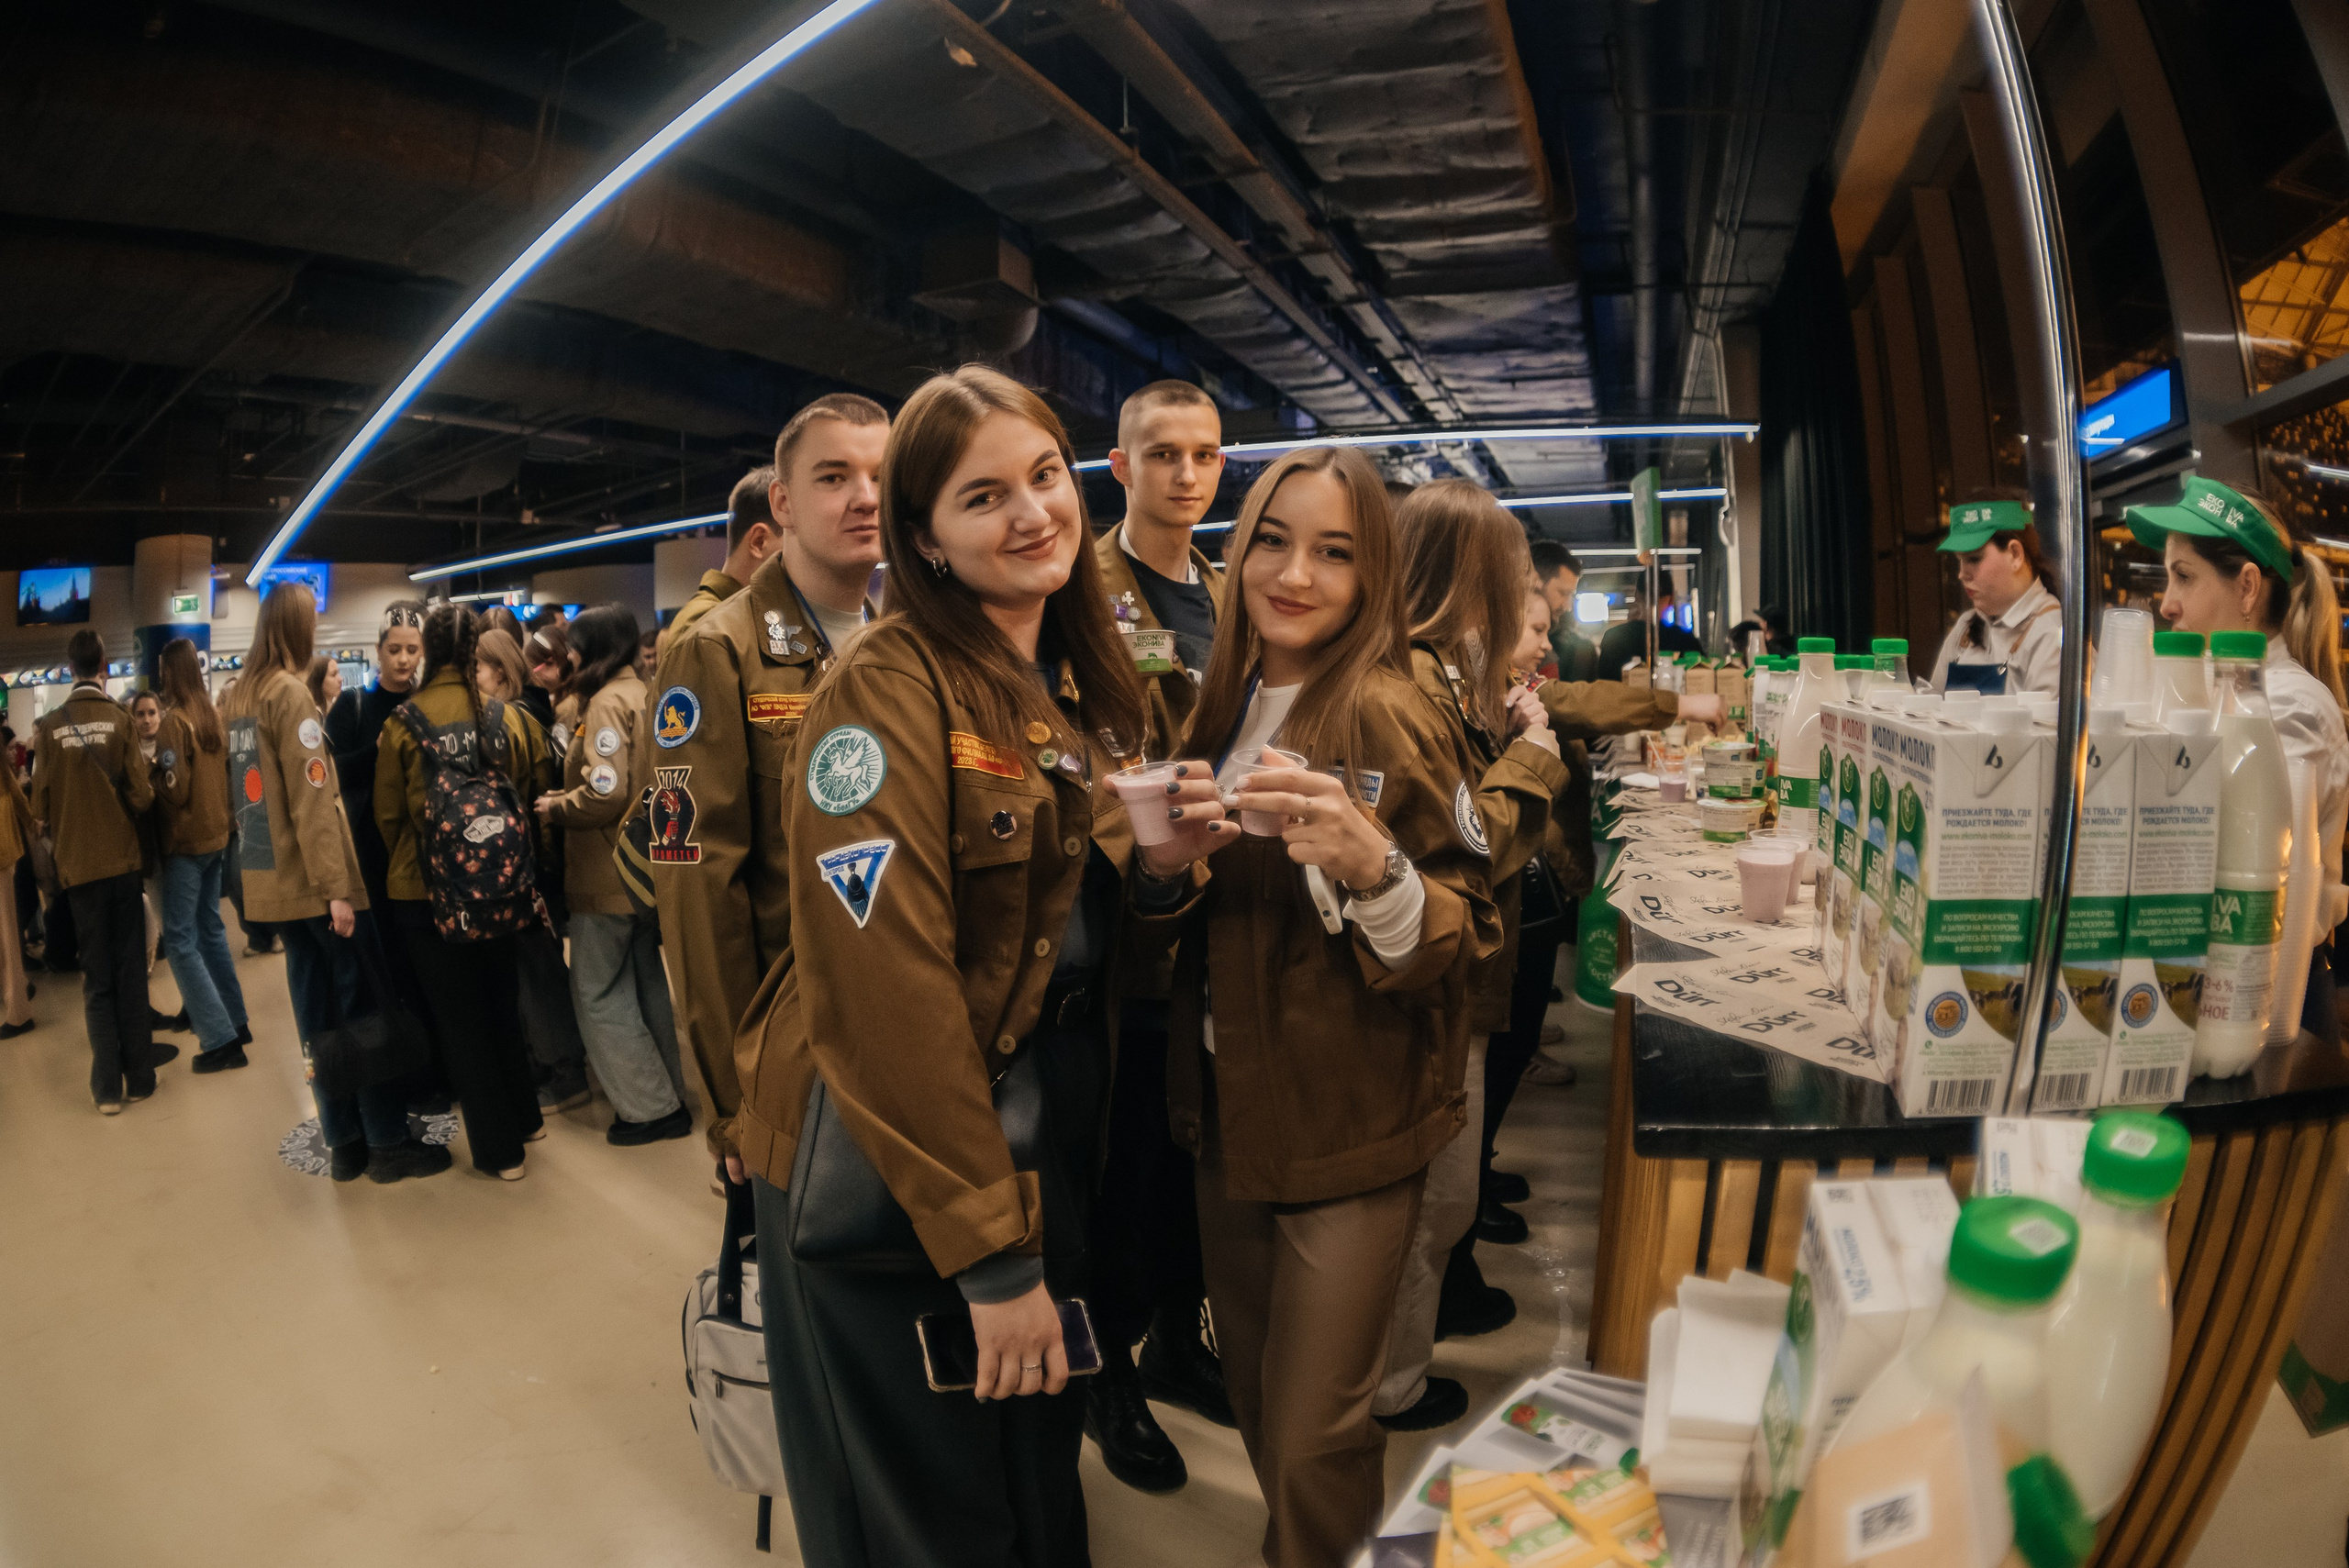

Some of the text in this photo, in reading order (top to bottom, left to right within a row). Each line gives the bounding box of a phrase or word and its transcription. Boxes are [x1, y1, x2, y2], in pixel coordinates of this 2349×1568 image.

[1136, 634, 1166, 642] EKONIVA
[70, 722, 115, 735] СУДЕНЧЕСКИХ
[957, 756, 973, 765] 2023
[659, 769, 686, 790] 2014
[1942, 807, 2032, 817] ПРИЕЗЖАЙТЕ ТУДА, ГДЕ
[2093, 807, 2128, 817] ТУДА, ГДЕ
[2139, 806, 2215, 816] ПРИЕЗЖАЙТЕ ТУДА, ГДЕ
[1946, 818, 2027, 828] РОЖДАЕТСЯ МОЛОКО!
[2143, 817, 2180, 825] РОЖДАЕТСЯ
[1941, 832, 2032, 840] www.ekoniva-moloko.com
[1702, 904, 1743, 915] Dür
[1987, 913, 2019, 921] КАЧЕСТВА
[1688, 929, 1746, 943] Dürr
[1729, 967, 1790, 984] Dürr
[1653, 979, 1722, 1007] Dürr
[1739, 1010, 1808, 1033] Dürr
